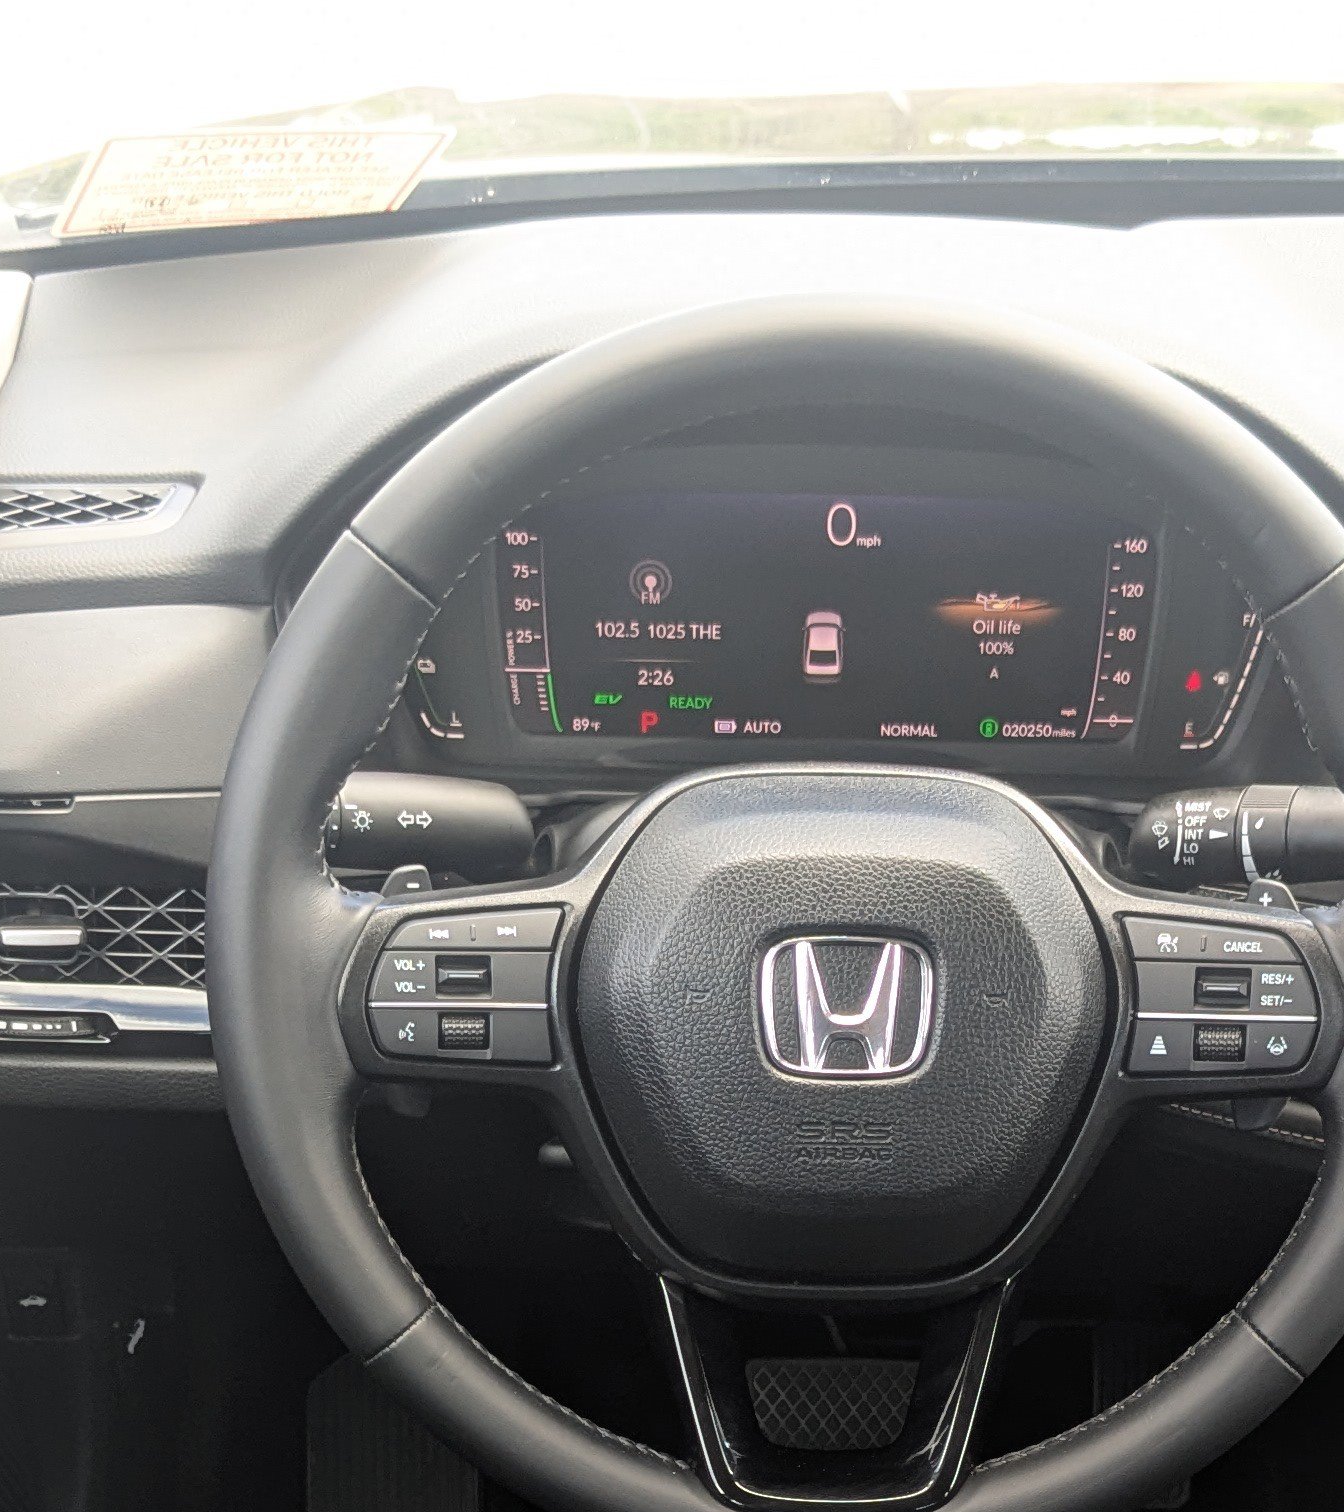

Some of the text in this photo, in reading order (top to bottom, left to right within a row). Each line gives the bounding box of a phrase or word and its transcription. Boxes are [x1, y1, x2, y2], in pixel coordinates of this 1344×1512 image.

[825, 501, 882, 548] 0 mph
[506, 532, 529, 546] 100
[1123, 539, 1148, 553] 160
[512, 565, 529, 579] 75
[641, 591, 661, 605] FM
[1120, 584, 1144, 598] 120
[514, 598, 531, 612] 50
[595, 621, 722, 640] 102.5 1025 THE
[972, 620, 1021, 635] Oil life
[1118, 628, 1136, 641] 80
[516, 630, 532, 643] 25
[978, 641, 1014, 655] 100%
[637, 670, 674, 686] 2:26
[989, 668, 999, 680] A
[1112, 671, 1130, 685] 40
[594, 694, 623, 705] EV
[669, 697, 713, 709] READY
[641, 711, 659, 733] P
[743, 721, 781, 734] AUTO
[880, 723, 937, 738] NORMAL
[1002, 725, 1052, 738] 020250
[1184, 802, 1212, 812] MIST
[1184, 815, 1208, 827] OFF
[1184, 829, 1204, 840] INT
[1183, 842, 1199, 854] LO
[1183, 856, 1195, 866] HI
[1223, 941, 1263, 953] CANCEL
